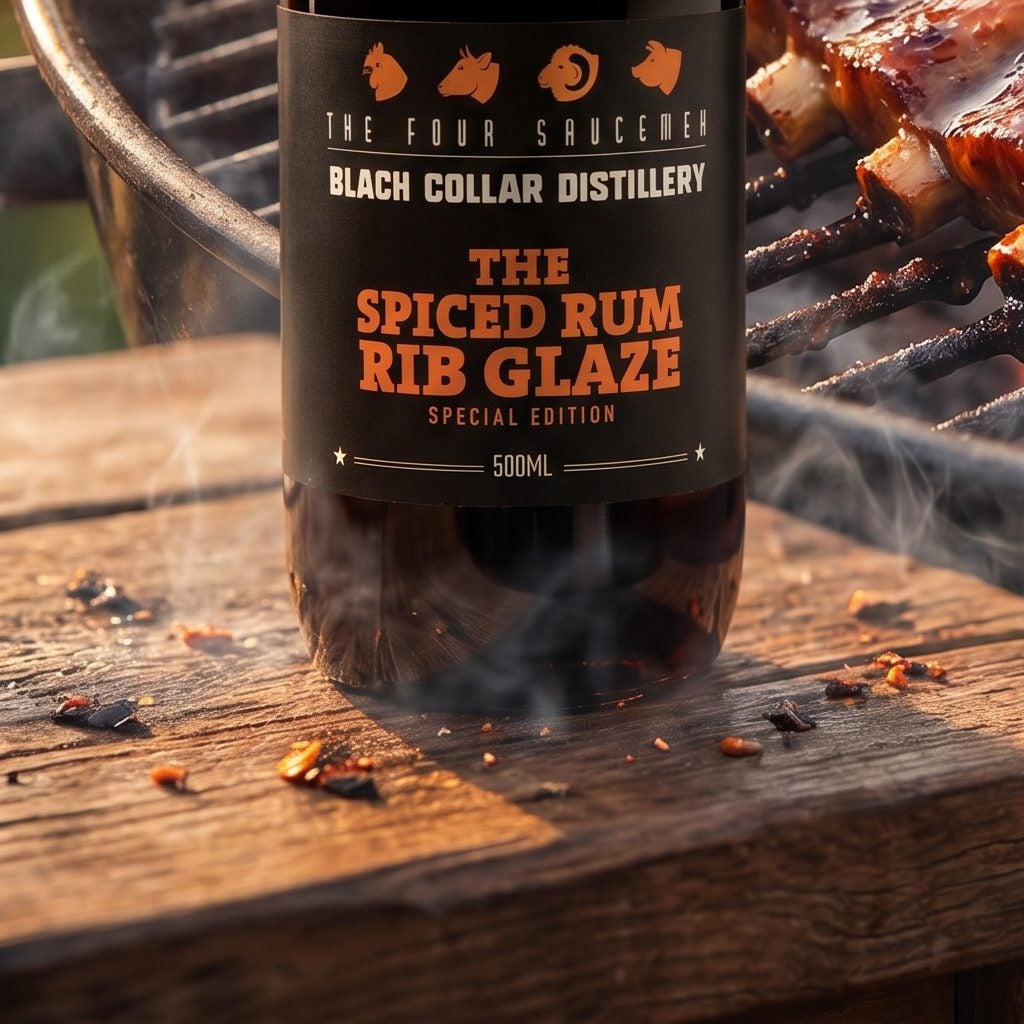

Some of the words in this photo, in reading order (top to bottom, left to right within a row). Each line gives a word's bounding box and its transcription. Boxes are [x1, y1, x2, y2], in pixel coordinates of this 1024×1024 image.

[326, 111, 373, 143] THE
[407, 117, 495, 148] FOUR
[424, 172, 543, 204] COLLAR
[558, 162, 706, 204] DISTILLERY
[468, 247, 570, 286] THE
[356, 288, 547, 340] SPICED
[560, 284, 684, 339] RUM
[358, 338, 467, 397] RIB
[483, 336, 682, 399] GLAZE
[428, 406, 518, 426] SPECIAL
[531, 404, 615, 426] EDITION
[493, 453, 553, 478] 500ML
